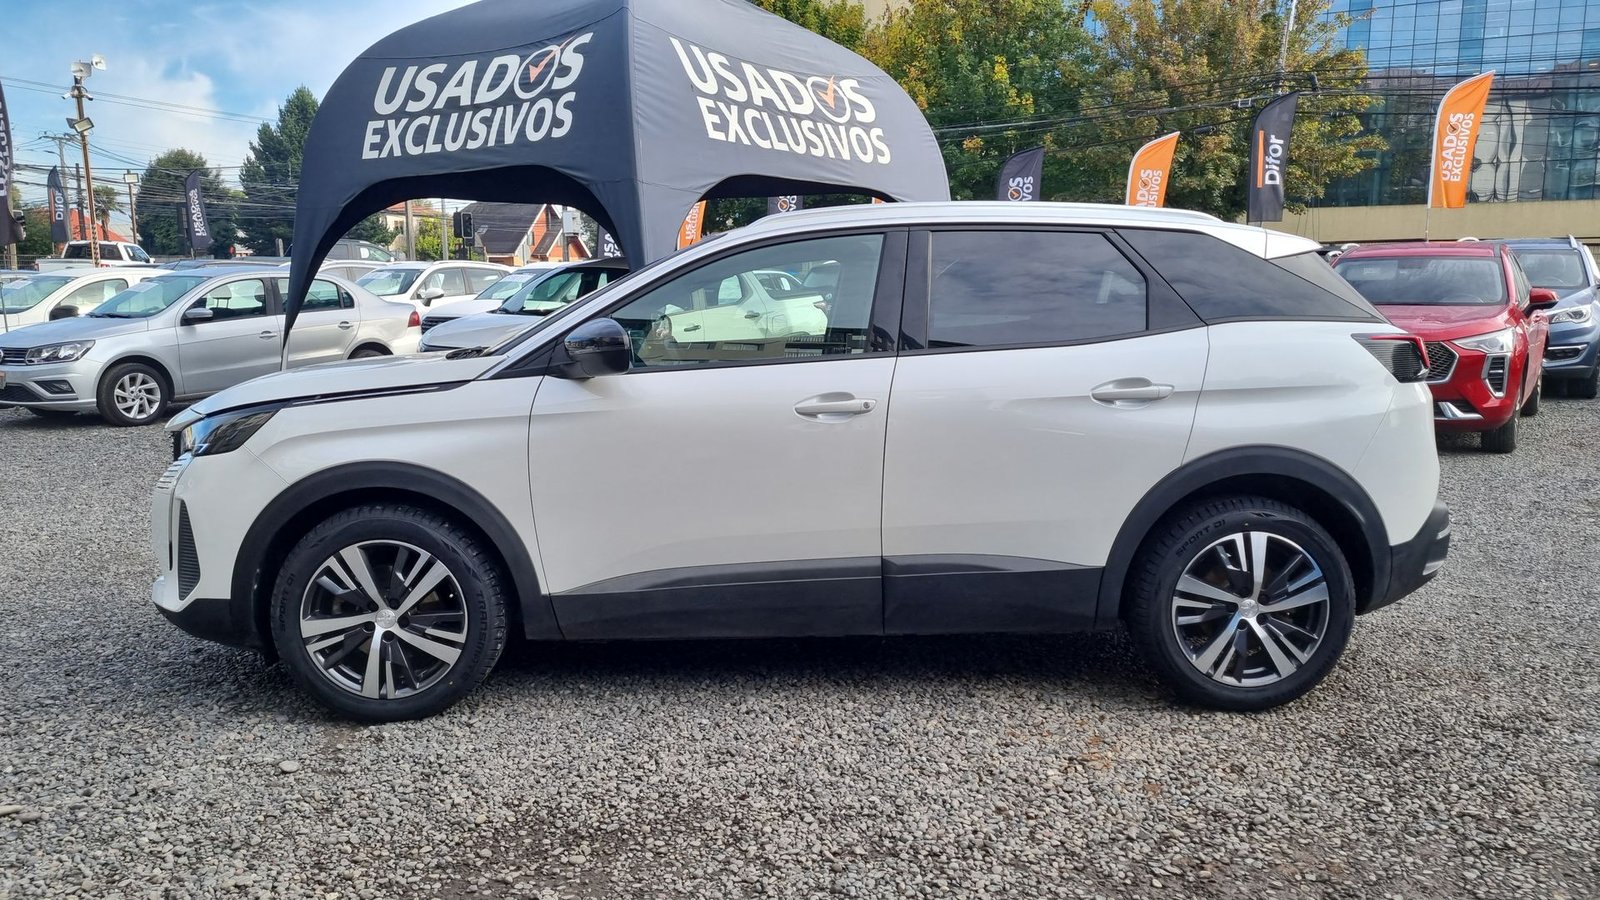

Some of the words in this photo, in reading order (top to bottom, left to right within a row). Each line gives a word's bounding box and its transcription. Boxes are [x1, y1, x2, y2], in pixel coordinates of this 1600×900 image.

[373, 32, 594, 115] USADOS
[669, 36, 876, 124] USADOS
[361, 91, 576, 160] EXCLUSIVOS
[696, 96, 891, 165] EXCLUSIVOS
[1264, 134, 1284, 185] Difor
[1441, 113, 1464, 181] USADOS
[1450, 112, 1475, 182] EXCLUSIVOS
